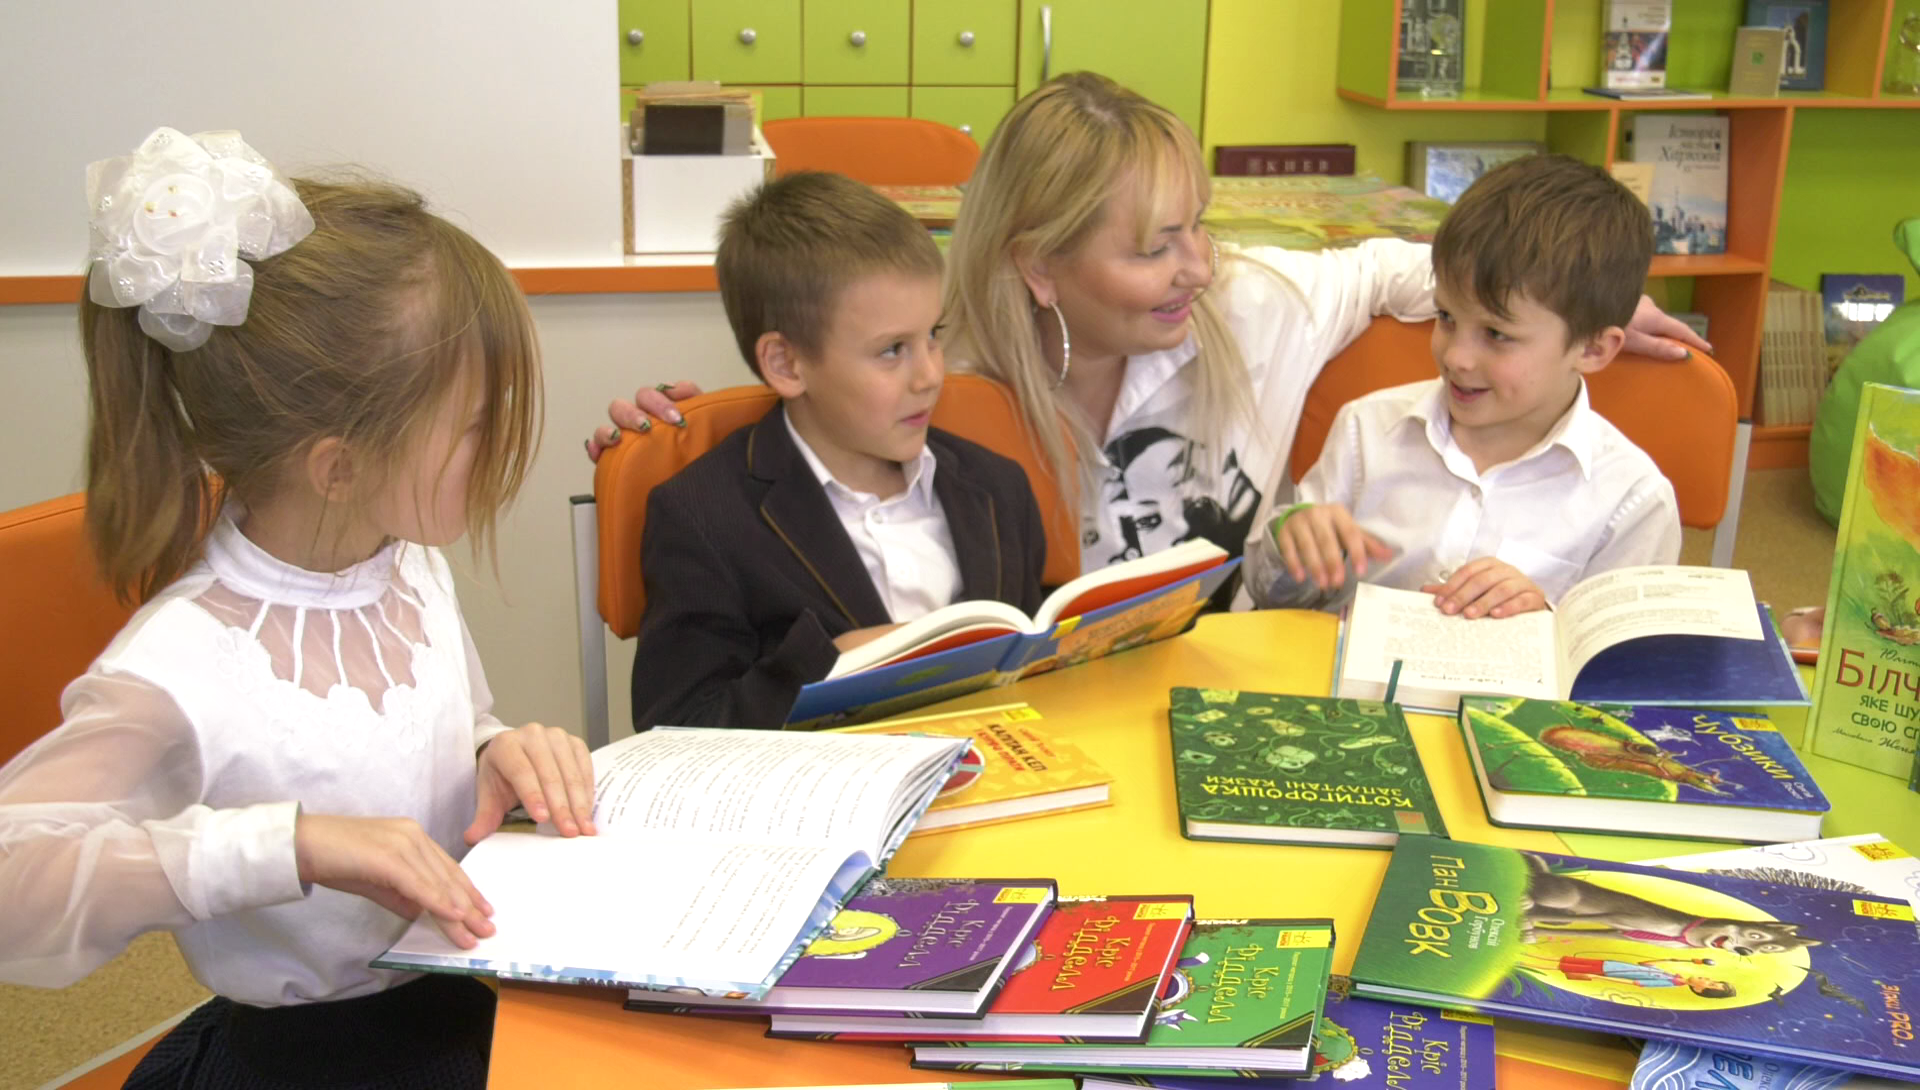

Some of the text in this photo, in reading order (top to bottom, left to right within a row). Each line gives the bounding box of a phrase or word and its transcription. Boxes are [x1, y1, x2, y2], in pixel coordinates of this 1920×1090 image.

[1859, 694, 1920, 721] ЯКЕ ШУ
[1851, 711, 1897, 734] СВОЮ
[1201, 782, 1414, 808] КОТИГОРОШКА
[1206, 775, 1403, 797] ЗАПЛУТАНІ КАЗКИ
[1094, 936, 1131, 968] Кріс
[1244, 966, 1279, 999] Кріс
[1413, 1037, 1450, 1075] Кріс
